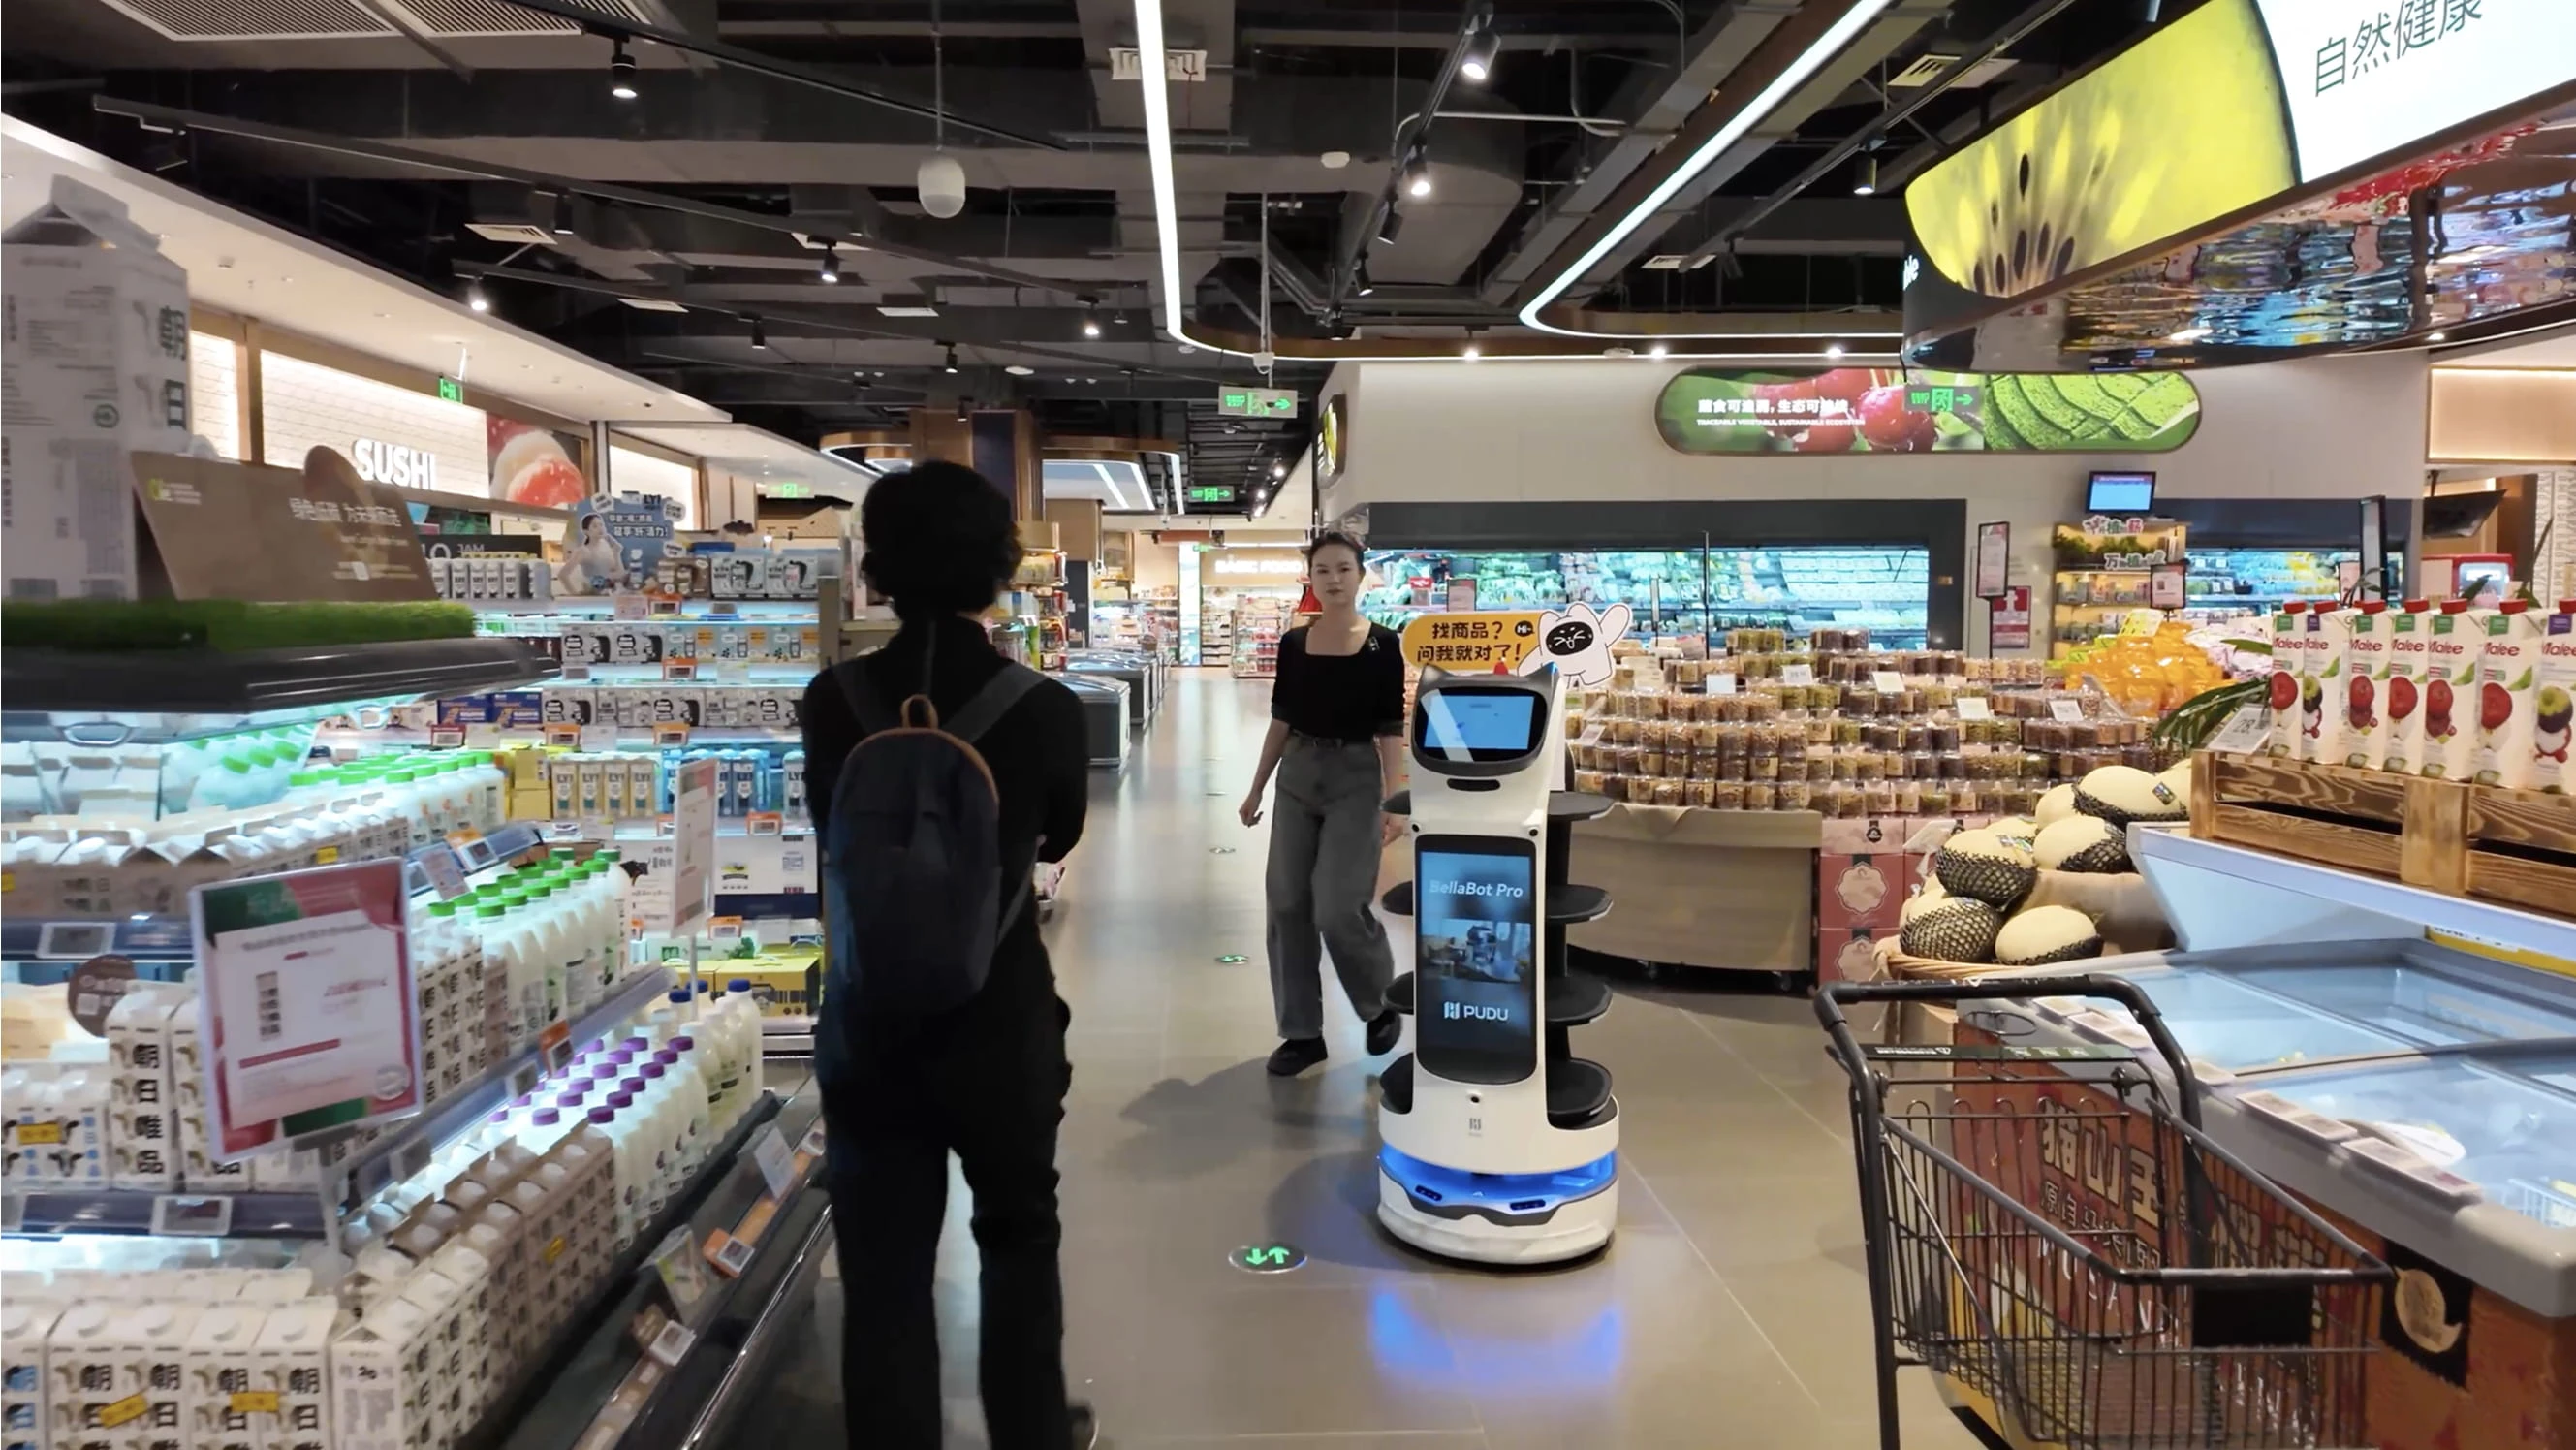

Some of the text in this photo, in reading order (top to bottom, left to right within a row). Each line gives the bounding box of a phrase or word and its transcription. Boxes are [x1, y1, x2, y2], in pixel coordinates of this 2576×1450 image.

[2315, 0, 2482, 97] 自然健康
[353, 438, 436, 490] SUSHI
[1431, 621, 1503, 640] 找商品？
[1417, 643, 1522, 662] 问我就对了！
[1429, 879, 1524, 898] BellaBot Pro
[1463, 1004, 1510, 1022] PUDU
